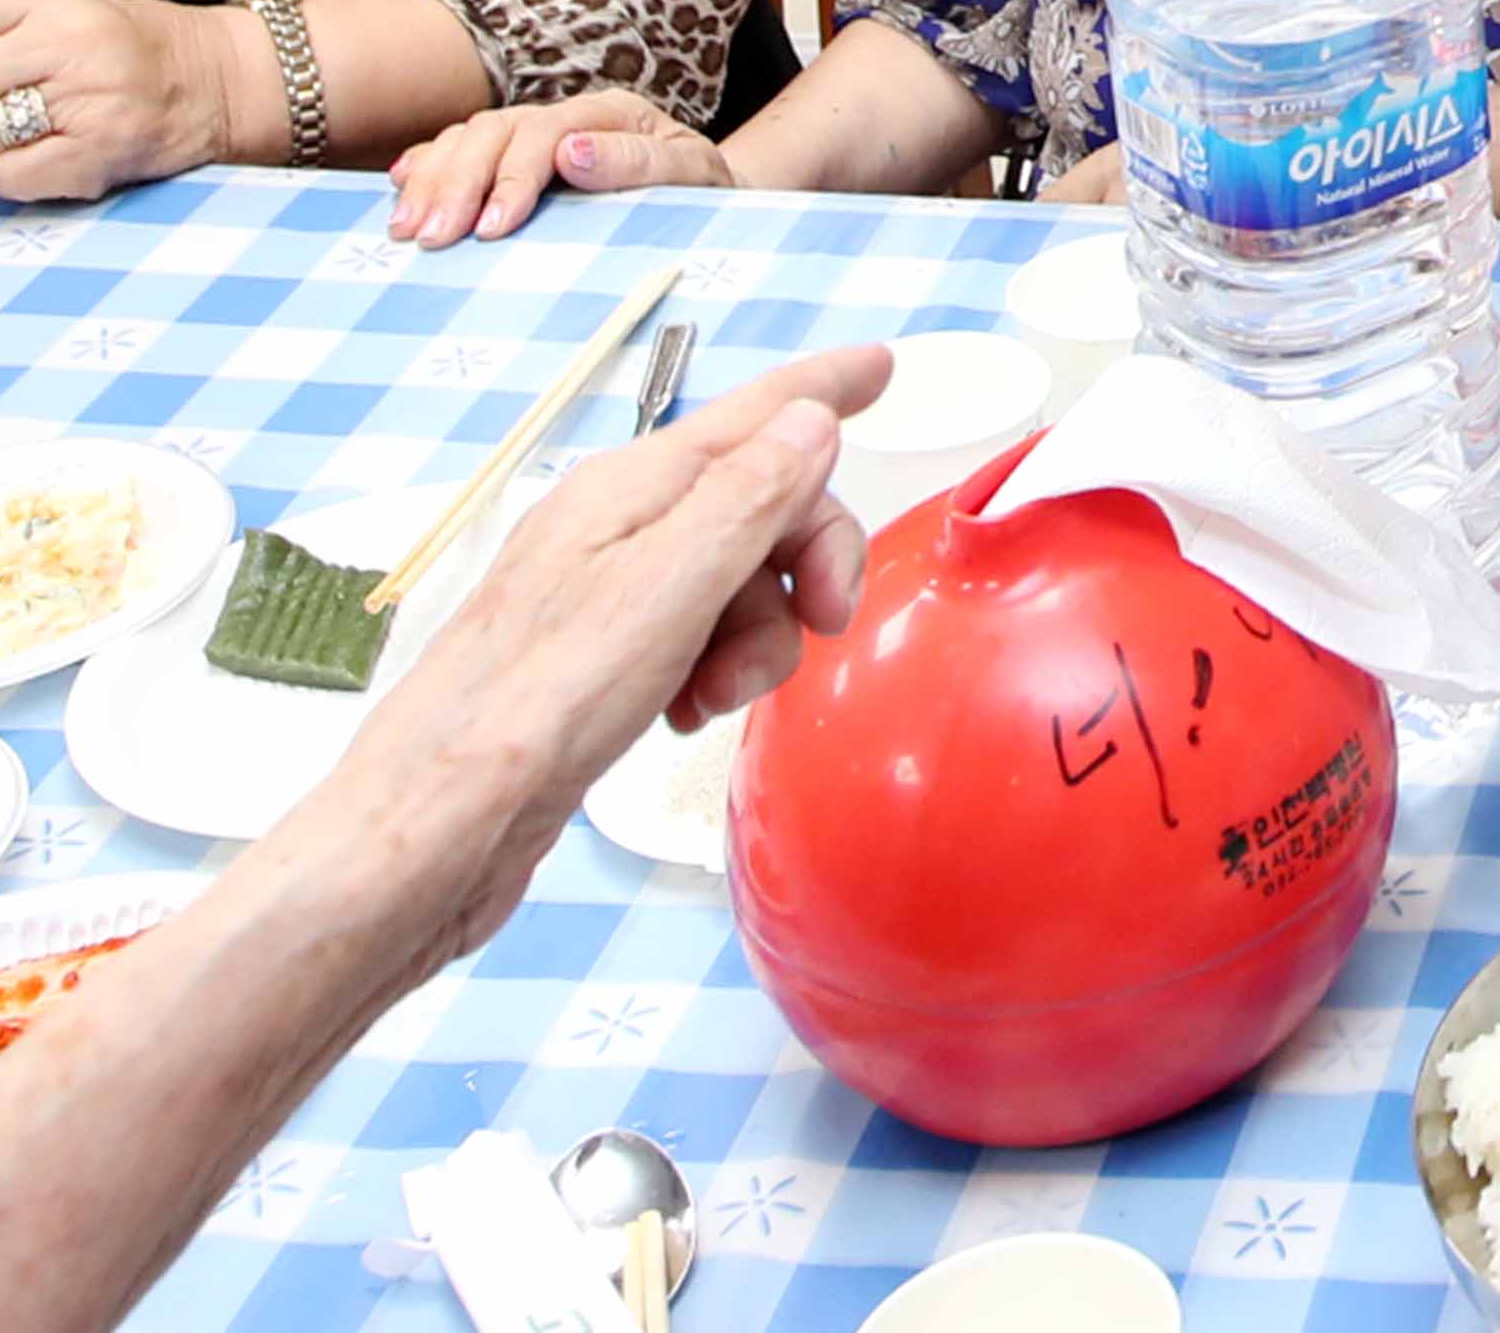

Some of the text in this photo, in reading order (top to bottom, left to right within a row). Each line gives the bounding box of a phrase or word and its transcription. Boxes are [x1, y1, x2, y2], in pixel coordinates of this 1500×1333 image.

[1288, 95, 1463, 185] 아이시스
[1315, 145, 1451, 207] Natural Mineral Water
